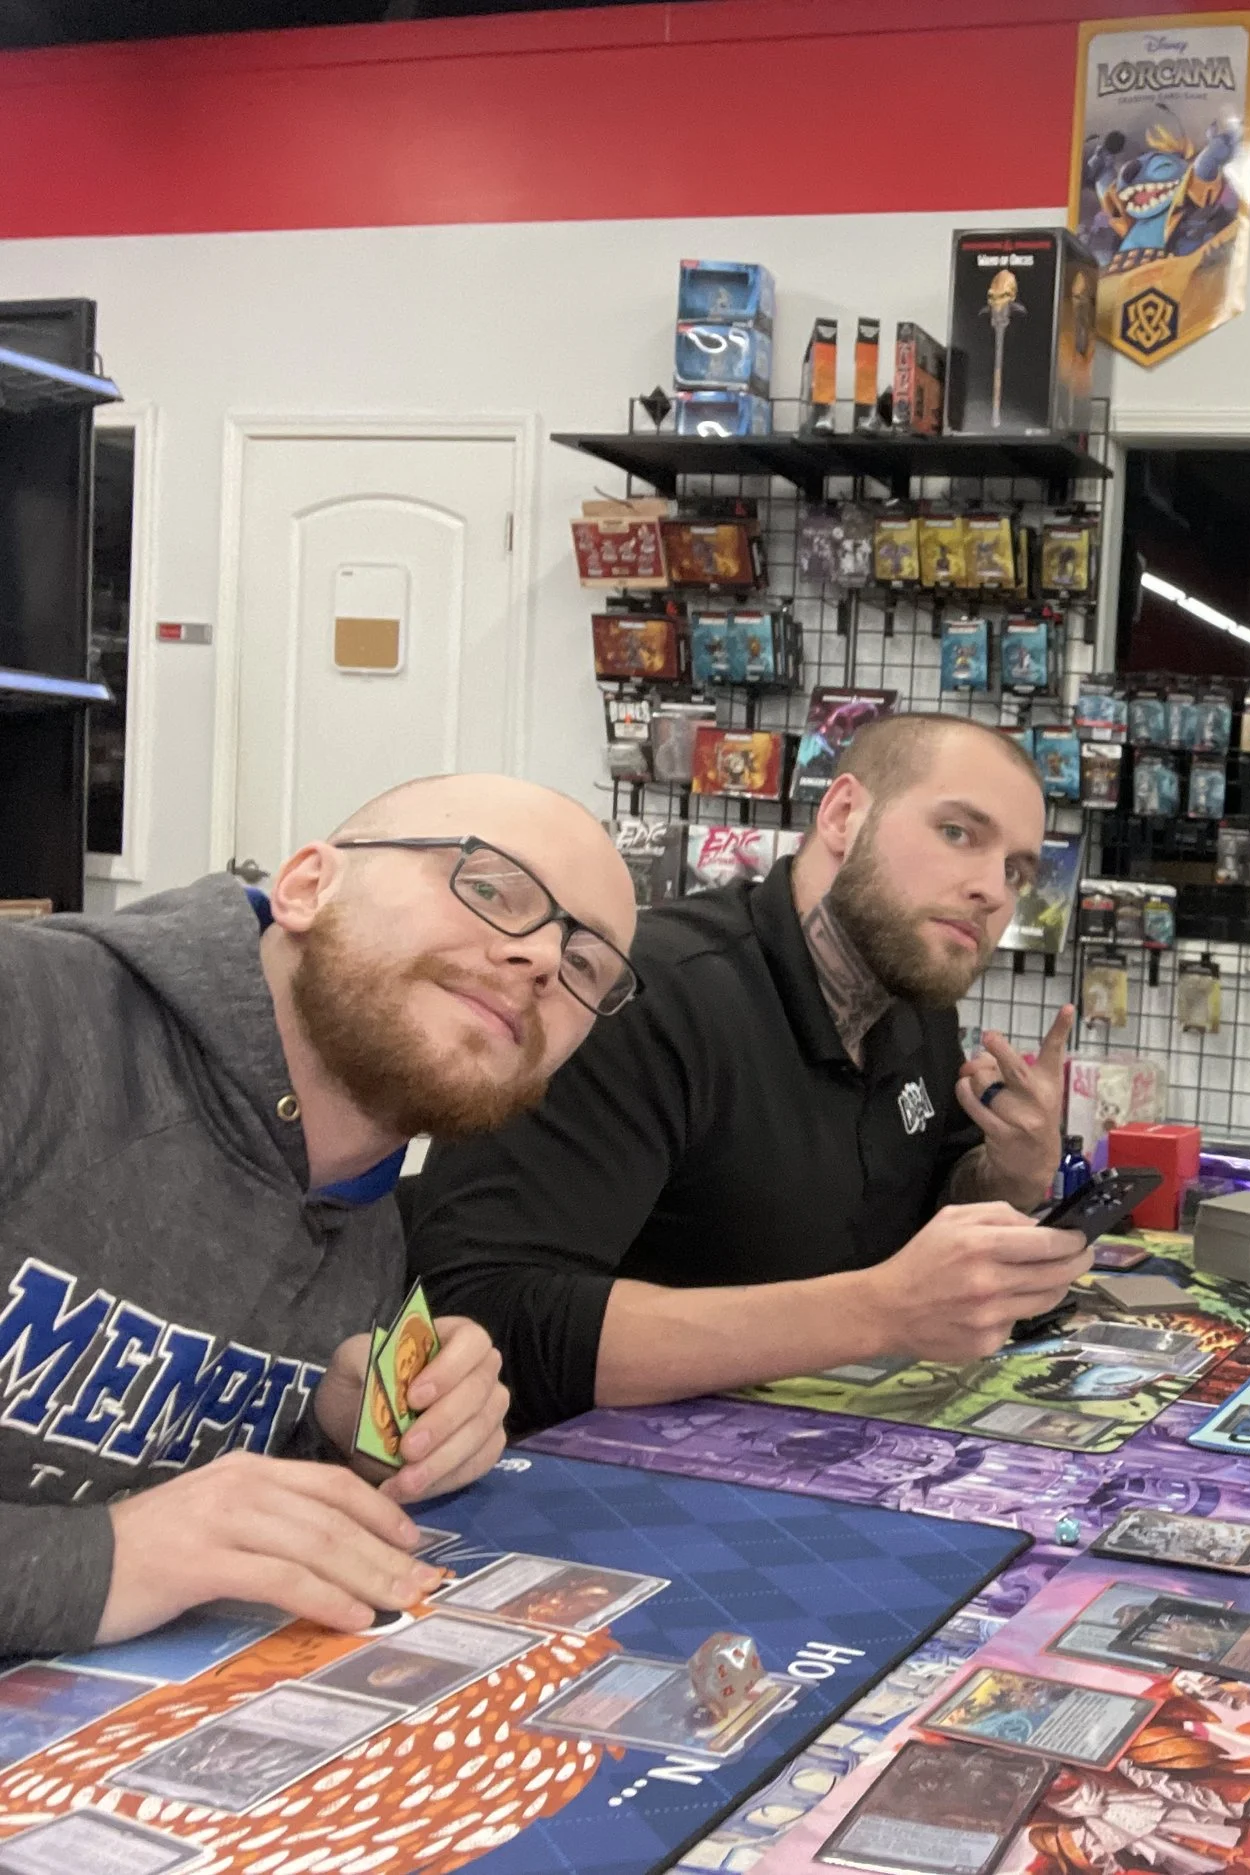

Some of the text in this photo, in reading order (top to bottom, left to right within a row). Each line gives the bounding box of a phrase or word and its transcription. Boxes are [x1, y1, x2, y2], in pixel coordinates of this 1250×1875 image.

[1145, 35, 1188, 53] Disney
[1097, 57, 1235, 97] LORCANA
[0, 1257, 326, 1469] MEMPH
